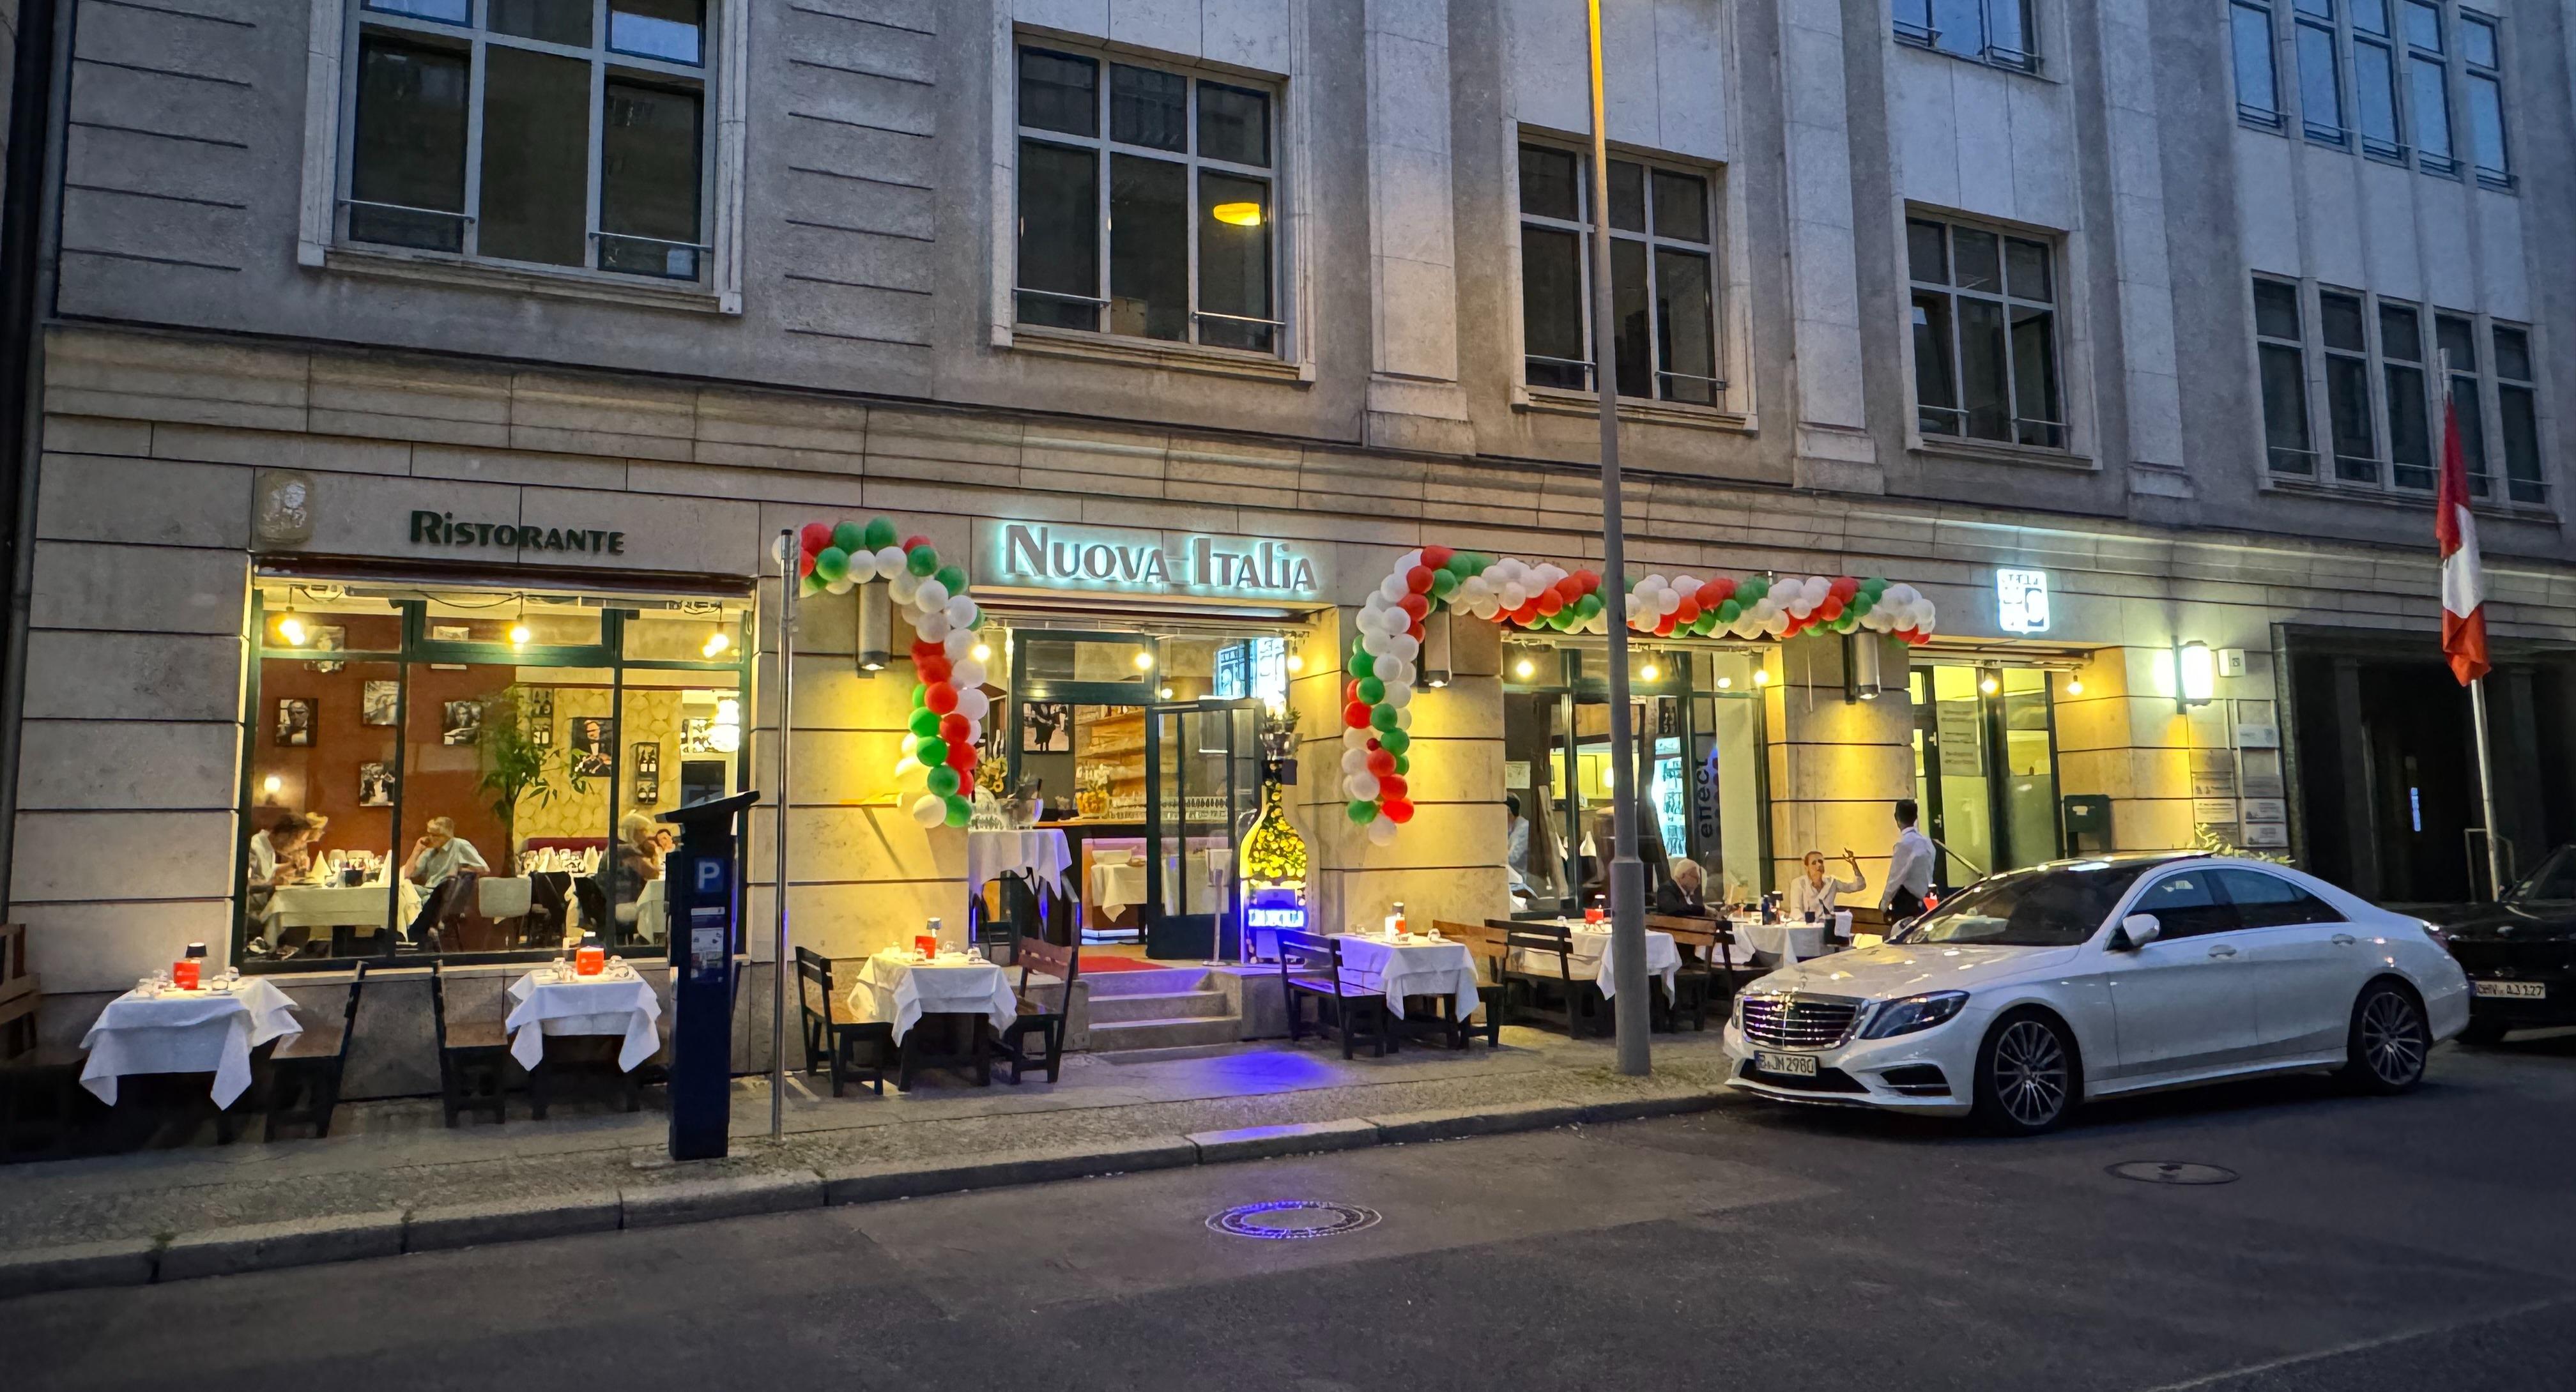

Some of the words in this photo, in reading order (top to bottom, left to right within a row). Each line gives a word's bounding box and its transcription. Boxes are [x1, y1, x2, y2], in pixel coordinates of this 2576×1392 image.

[1004, 524, 1171, 584] NUOVA
[698, 861, 721, 889] P
[1786, 1057, 1814, 1074] 2980
